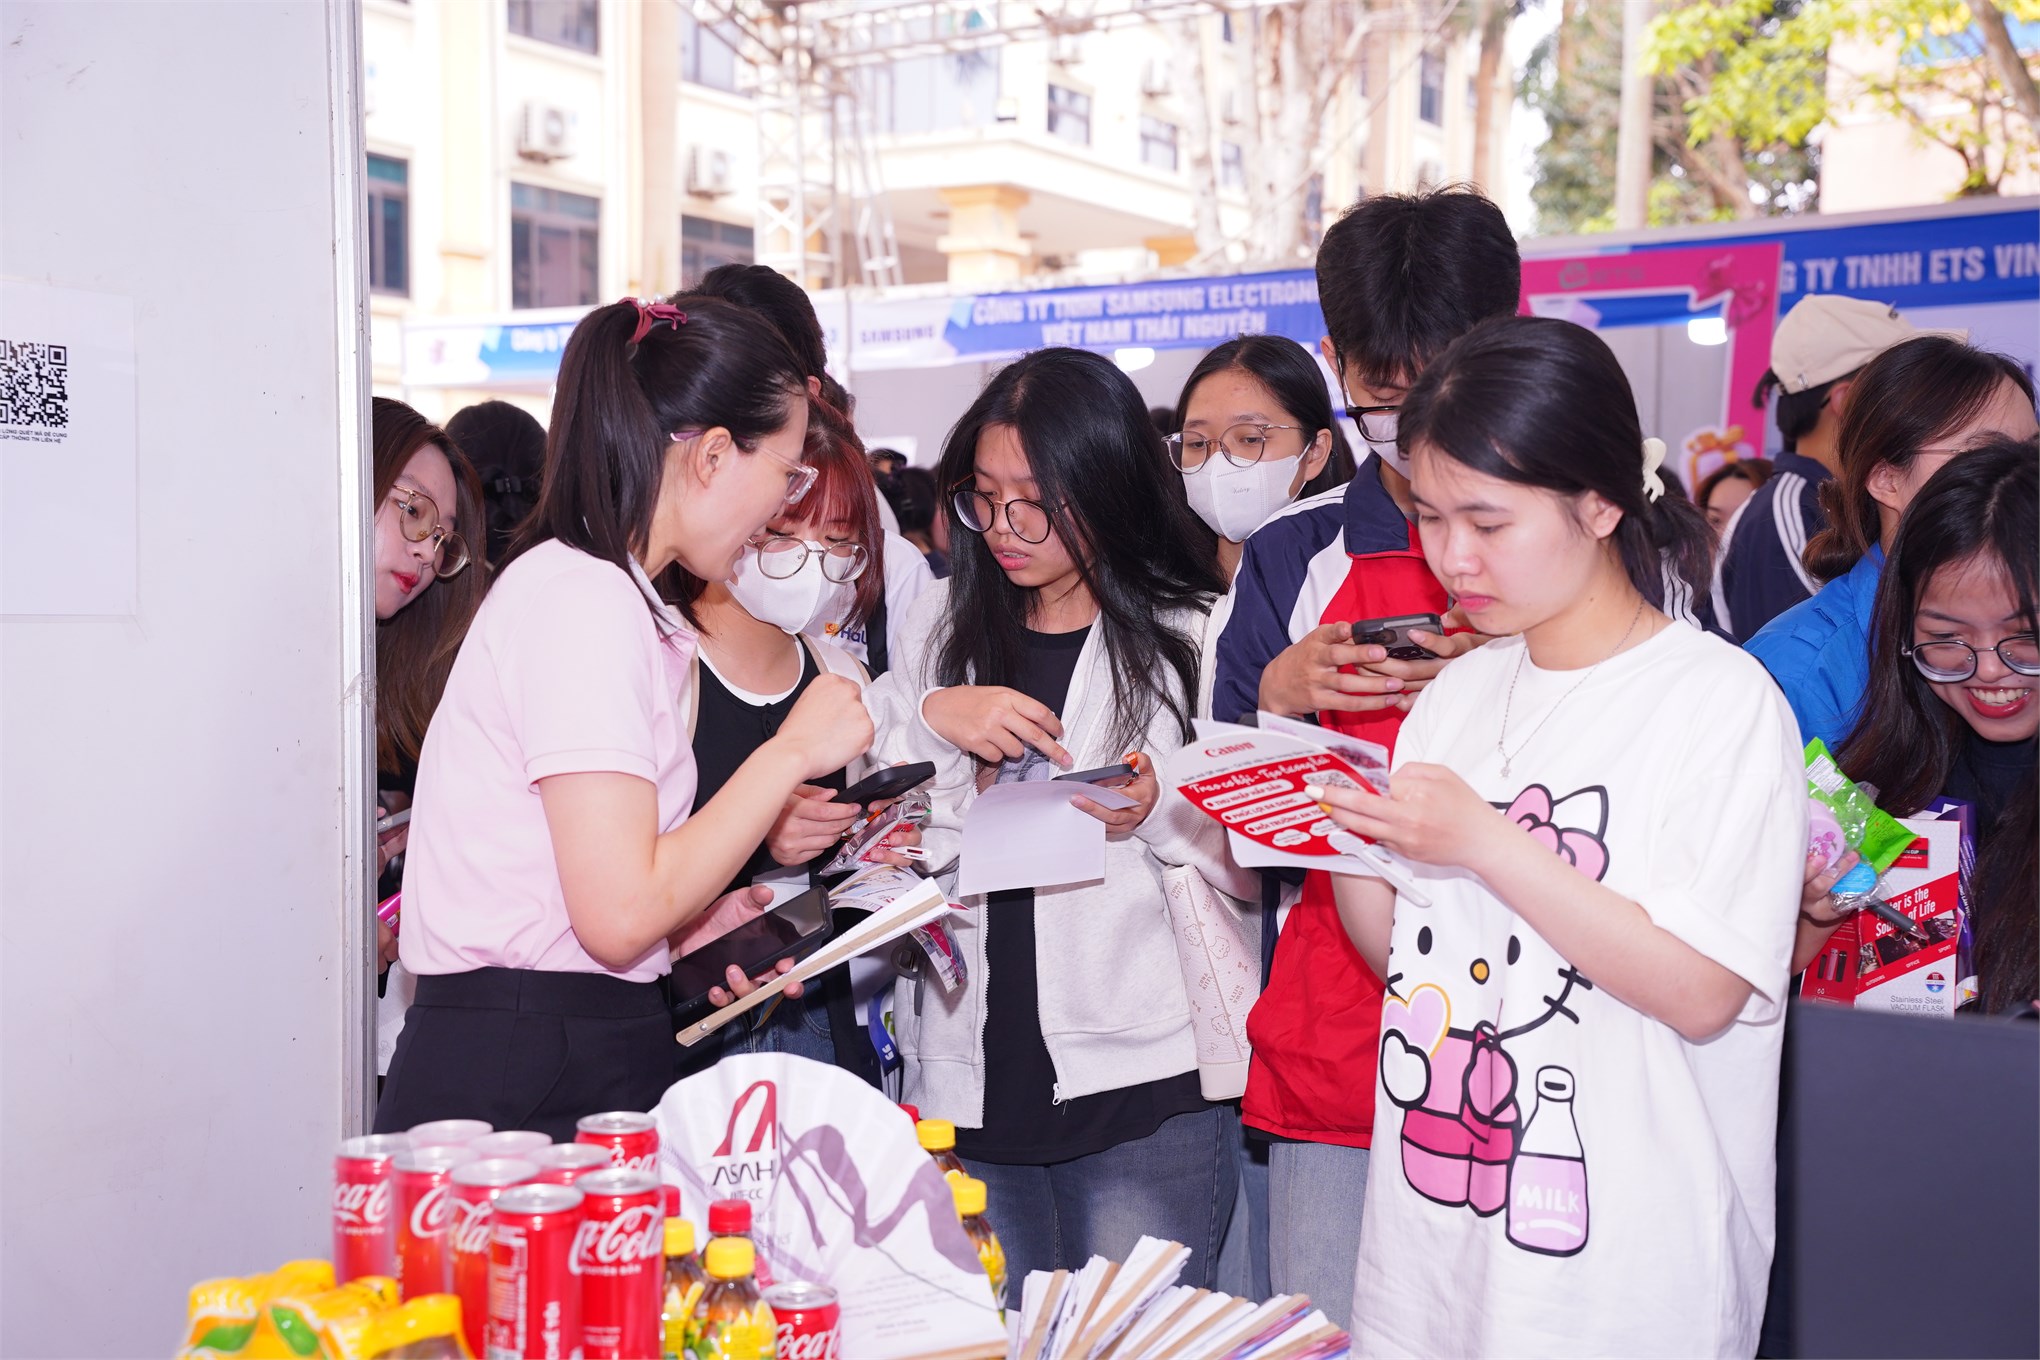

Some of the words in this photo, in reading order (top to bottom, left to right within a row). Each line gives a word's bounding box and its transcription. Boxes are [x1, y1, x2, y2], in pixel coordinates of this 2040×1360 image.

[1804, 258, 1839, 291] TY
[1844, 251, 1922, 289] TNHH
[1929, 246, 1986, 284] ETS
[1106, 286, 1205, 316] SAMSUNG
[1204, 741, 1256, 758] Canon
[1904, 894, 1912, 908] is
[1914, 888, 1929, 904] the
[1908, 905, 1918, 920] of
[1920, 901, 1936, 918] Life
[1890, 995, 1923, 1005] Stainless
[1924, 996, 1945, 1005] Steel
[1890, 1004, 1921, 1012] VACUUM
[1922, 1004, 1946, 1013] FLASK
[1516, 1184, 1580, 1214] MILK
